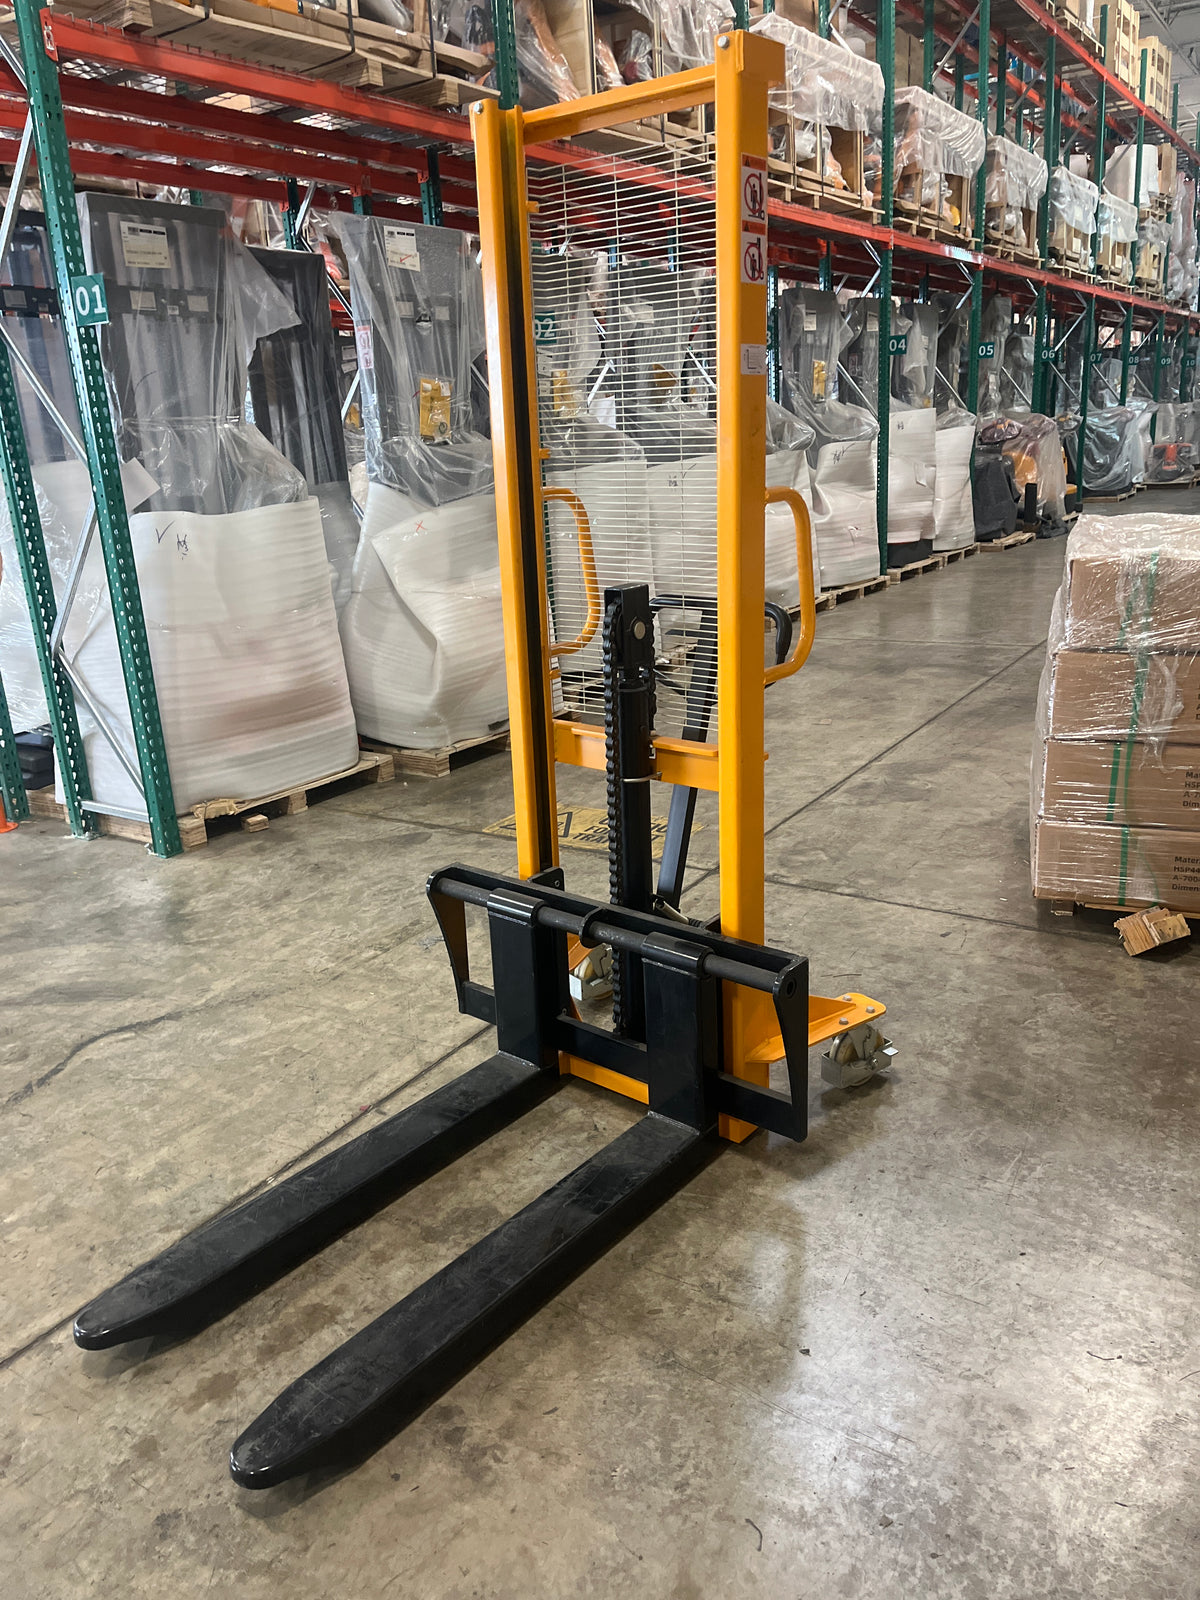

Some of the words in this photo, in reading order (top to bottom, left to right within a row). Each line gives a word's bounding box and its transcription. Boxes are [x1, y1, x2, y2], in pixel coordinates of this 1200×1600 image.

[75, 284, 107, 316] 01
[889, 338, 907, 352] 04
[978, 344, 994, 356] 05
[1041, 349, 1056, 360] 06
[1090, 353, 1102, 362] 07
[1128, 356, 1140, 364] 08
[1160, 357, 1171, 365] 09
[1174, 856, 1200, 865] Mater
[1172, 875, 1200, 883] A-700
[1171, 884, 1200, 892] Dimen
